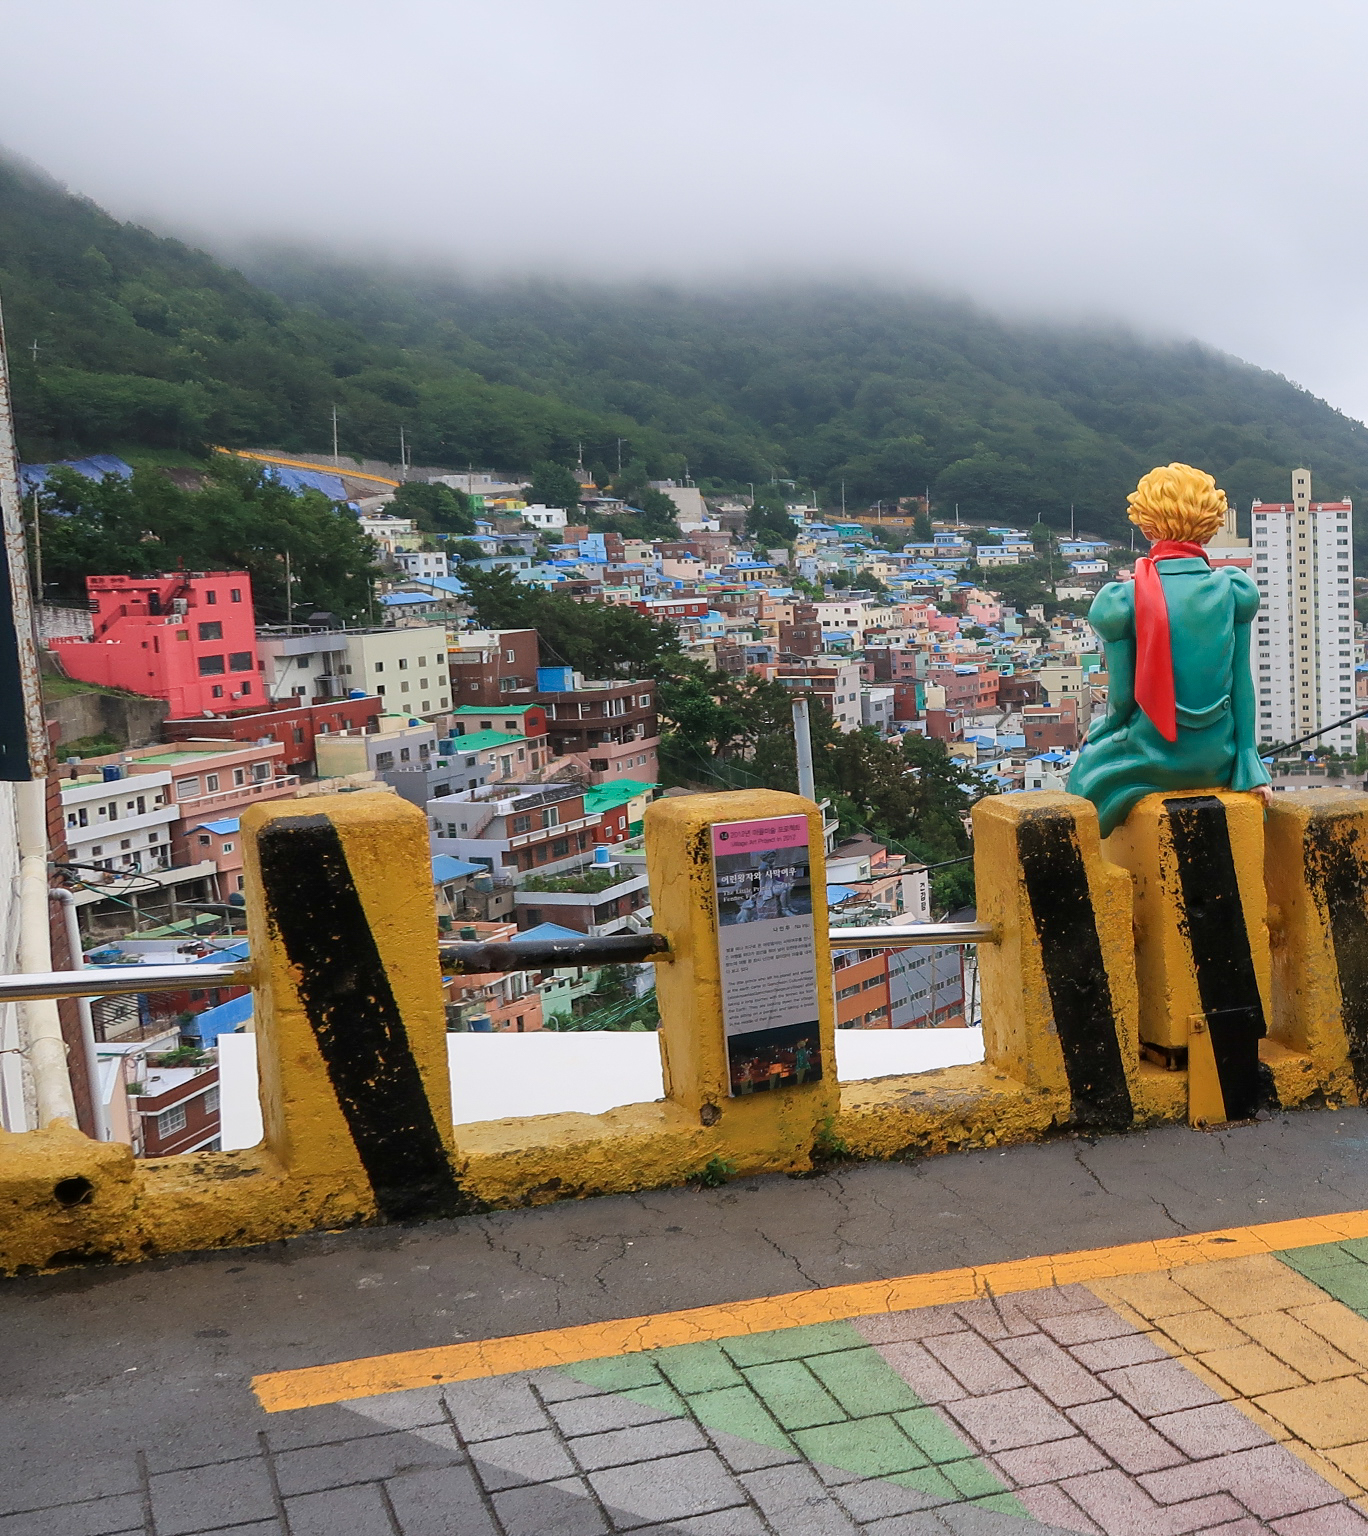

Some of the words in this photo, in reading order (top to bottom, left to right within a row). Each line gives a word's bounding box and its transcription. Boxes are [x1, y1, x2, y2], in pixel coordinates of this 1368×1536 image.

[730, 830, 751, 839] 2012년
[753, 827, 776, 836] 마을미술
[779, 824, 801, 833] 프로젝트
[721, 871, 762, 885] 어린왕자와
[765, 867, 797, 879] 사막여우
